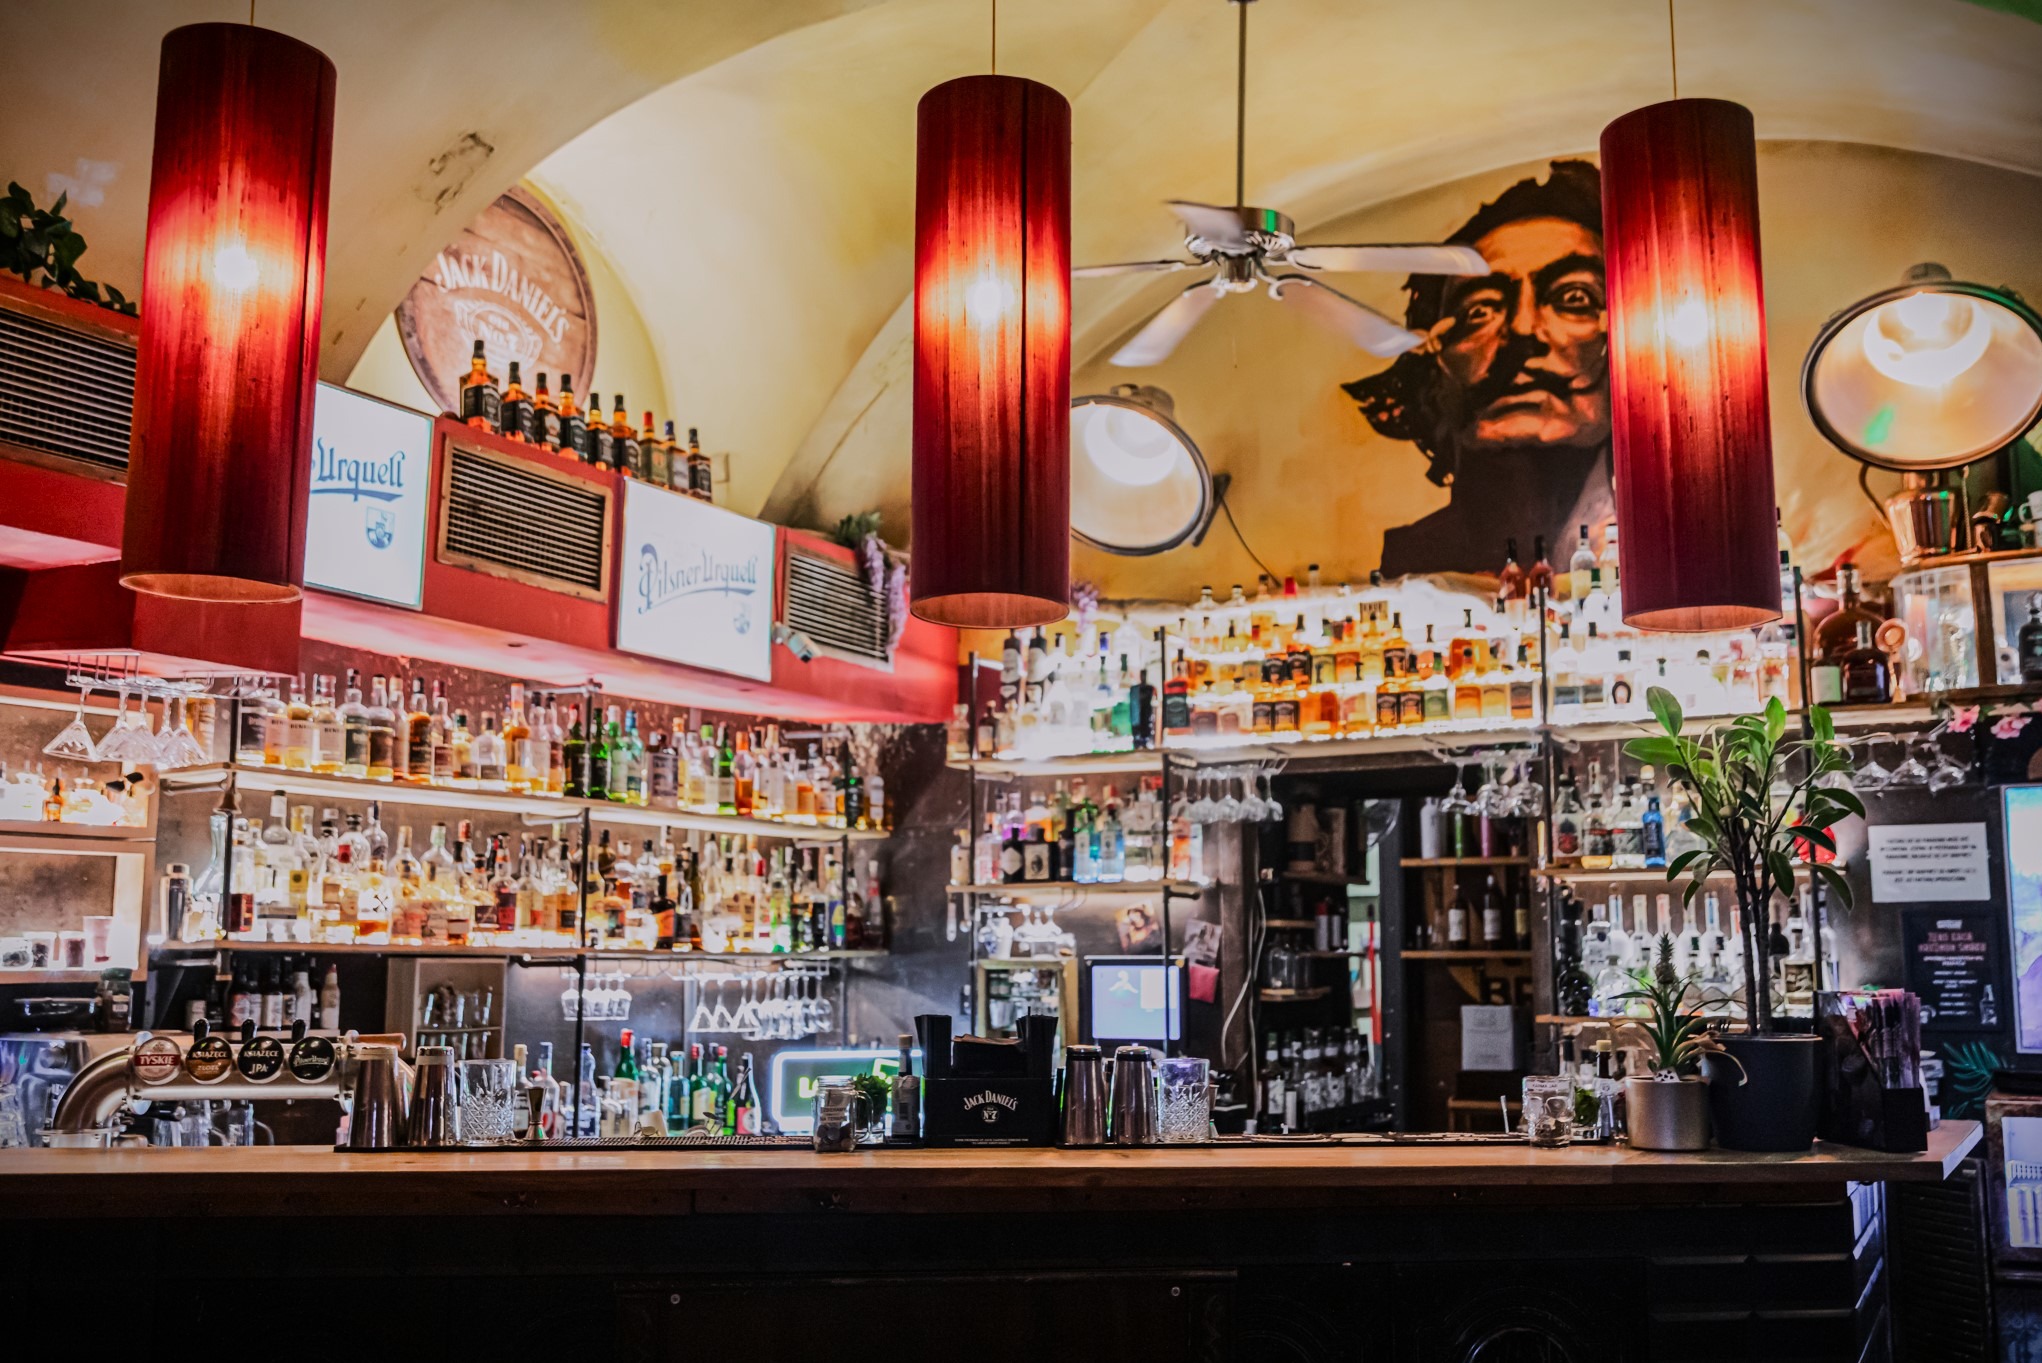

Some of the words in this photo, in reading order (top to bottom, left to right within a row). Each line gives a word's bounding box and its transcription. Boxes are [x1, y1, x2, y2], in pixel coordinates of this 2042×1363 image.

[433, 251, 490, 294] JACK
[491, 250, 570, 343] DANIEL'S
[317, 437, 406, 502] Urquell
[637, 543, 701, 615] Pilsner
[702, 550, 758, 597] Urquell
[139, 1055, 175, 1065] TYSKIE
[963, 1093, 985, 1110] JACK
[985, 1090, 1019, 1111] DANIEL'S
